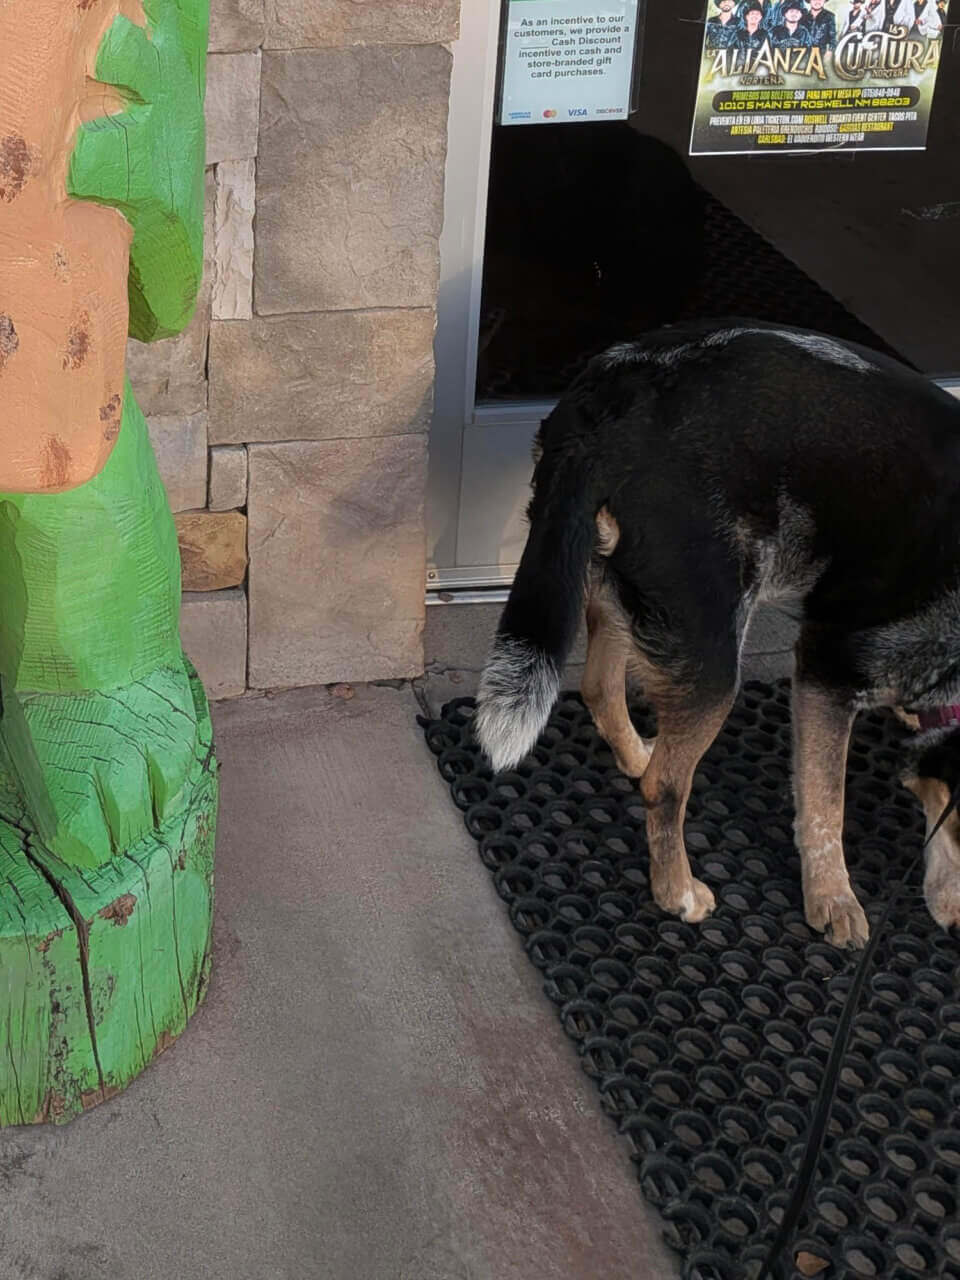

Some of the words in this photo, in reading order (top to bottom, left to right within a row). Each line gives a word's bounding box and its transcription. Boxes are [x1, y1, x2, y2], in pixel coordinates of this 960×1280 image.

[520, 19, 533, 27] As
[551, 16, 593, 25] incentive
[514, 29, 567, 38] customers,
[585, 25, 625, 36] provide
[551, 38, 575, 46] Cash
[578, 36, 621, 45] Discount
[518, 49, 562, 58] incentive
[579, 46, 601, 55] cash
[604, 46, 622, 54] and
[527, 58, 593, 68] store-branded
[596, 56, 612, 66] gift
[706, 39, 826, 82] ALIANZA
[531, 69, 552, 78] card
[554, 68, 606, 79] purchases.
[719, 102, 745, 110] 1010
[755, 101, 781, 109] MAIN
[783, 101, 798, 109] ST
[800, 99, 853, 109] ROSWELL
[854, 98, 870, 107] NM
